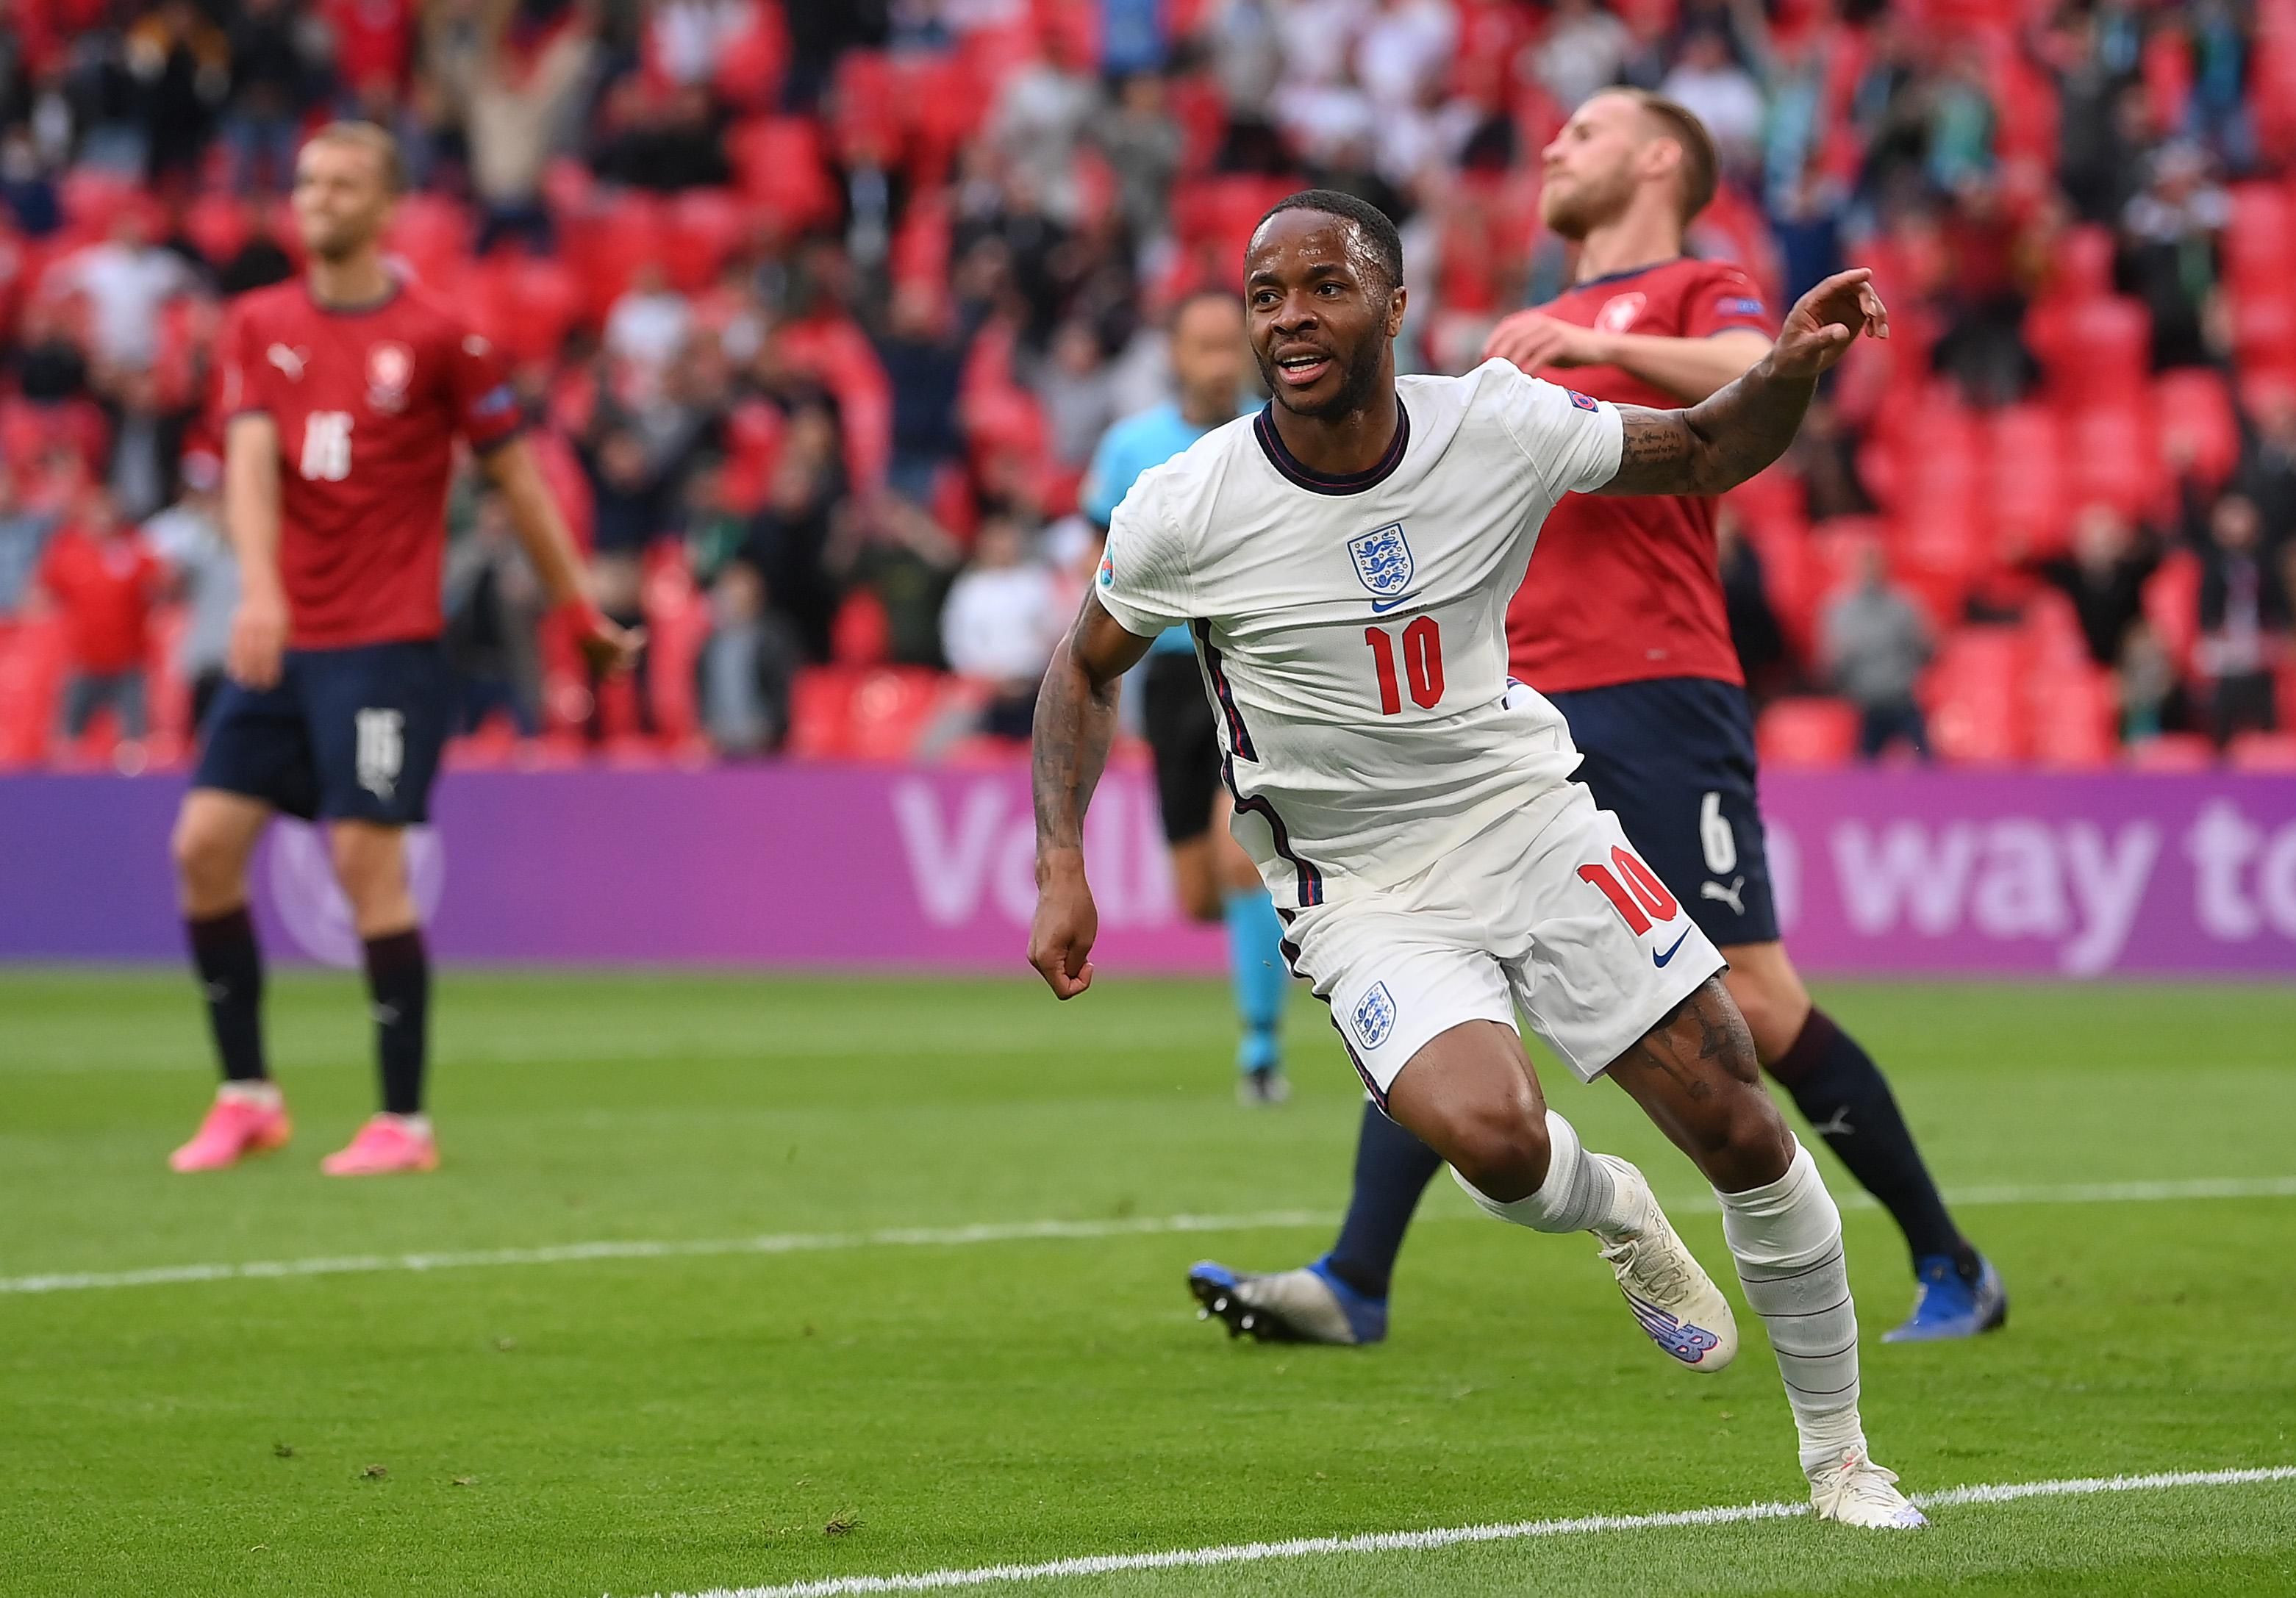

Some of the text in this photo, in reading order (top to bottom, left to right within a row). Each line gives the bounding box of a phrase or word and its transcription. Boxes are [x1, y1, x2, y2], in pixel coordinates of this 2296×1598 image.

[1365, 615, 1445, 715] 10
[1700, 791, 1737, 875] 6
[1577, 845, 1677, 936] 10
[1830, 819, 2161, 977] way
